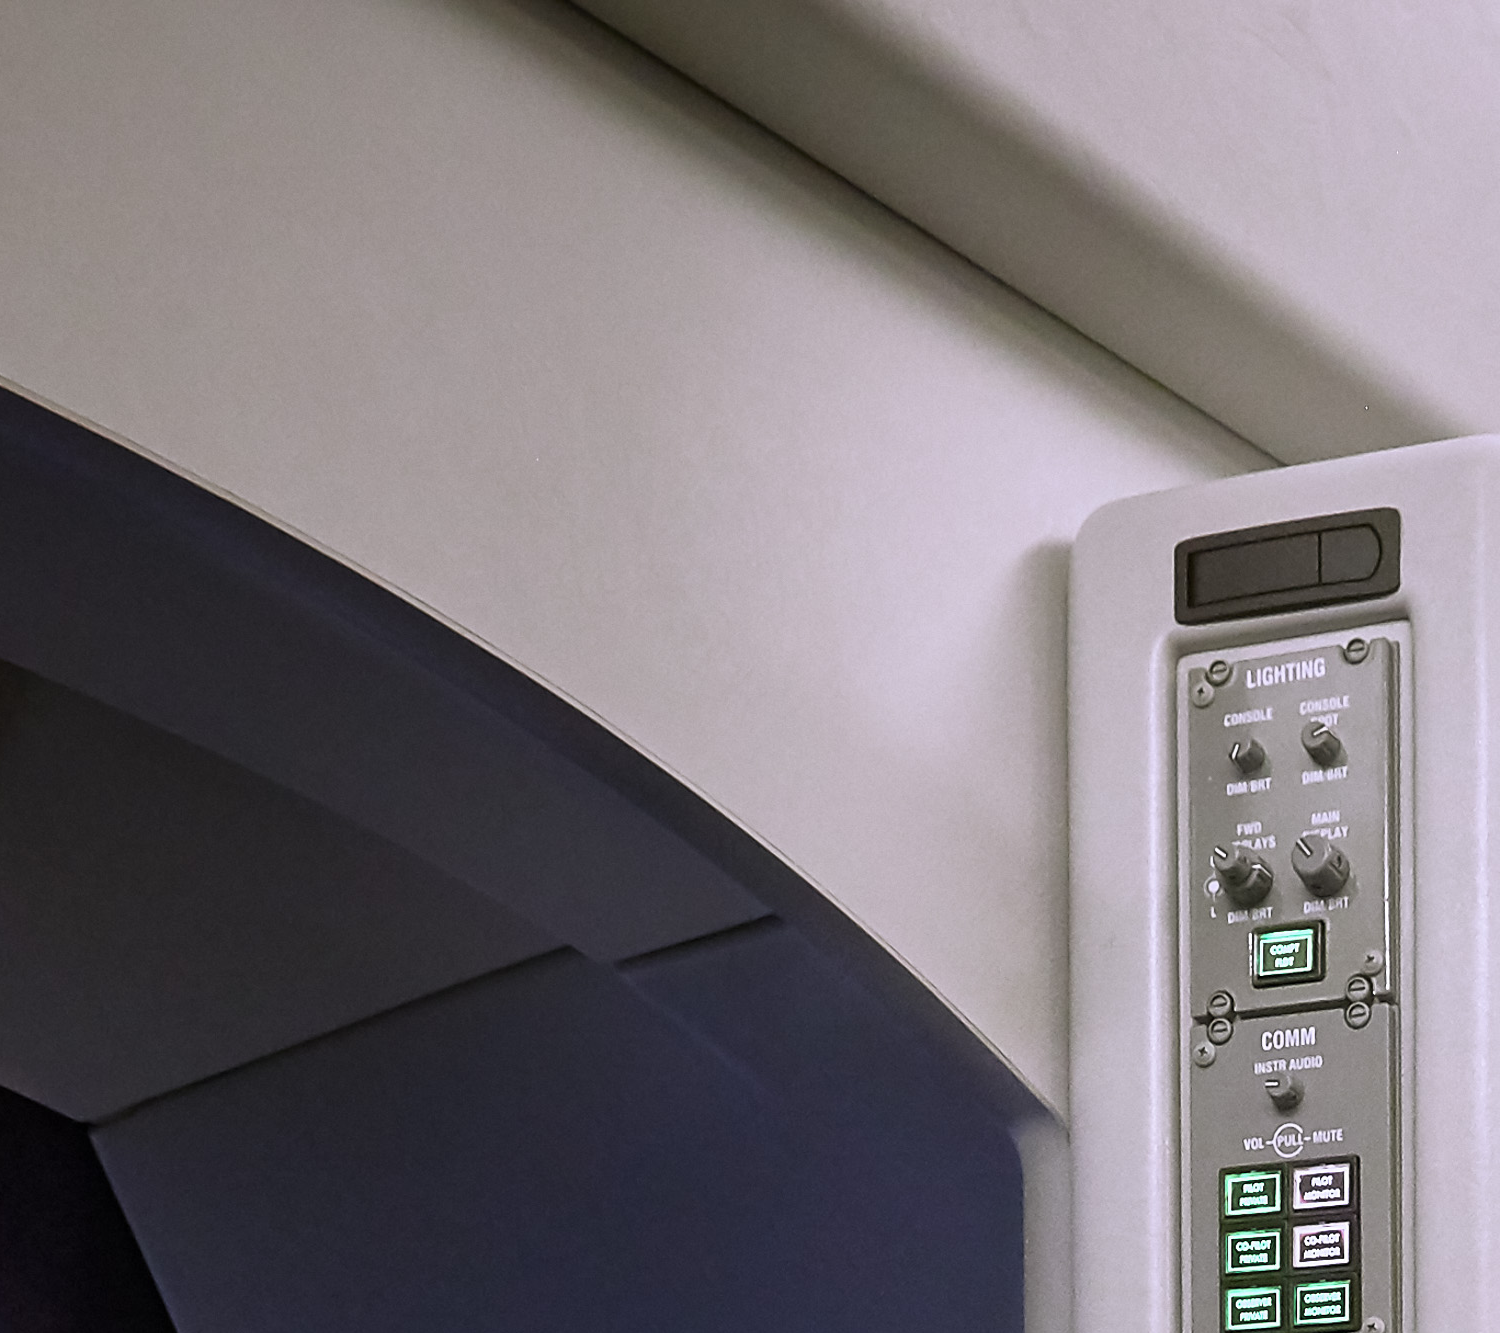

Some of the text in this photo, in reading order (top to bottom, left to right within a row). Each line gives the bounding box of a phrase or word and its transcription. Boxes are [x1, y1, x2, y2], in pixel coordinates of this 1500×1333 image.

[1246, 658, 1326, 688] LIGHTING
[1300, 696, 1349, 715] CONSOLE
[1224, 708, 1273, 727] CONSOLE
[1226, 778, 1271, 795] DIM BRT
[1311, 811, 1340, 824] MAIN
[1237, 822, 1262, 835] FWD
[1261, 1027, 1316, 1050] COMM
[1254, 1055, 1323, 1074] INSTR AUDIO
[1243, 1129, 1343, 1151] VOL PULL MUTE
